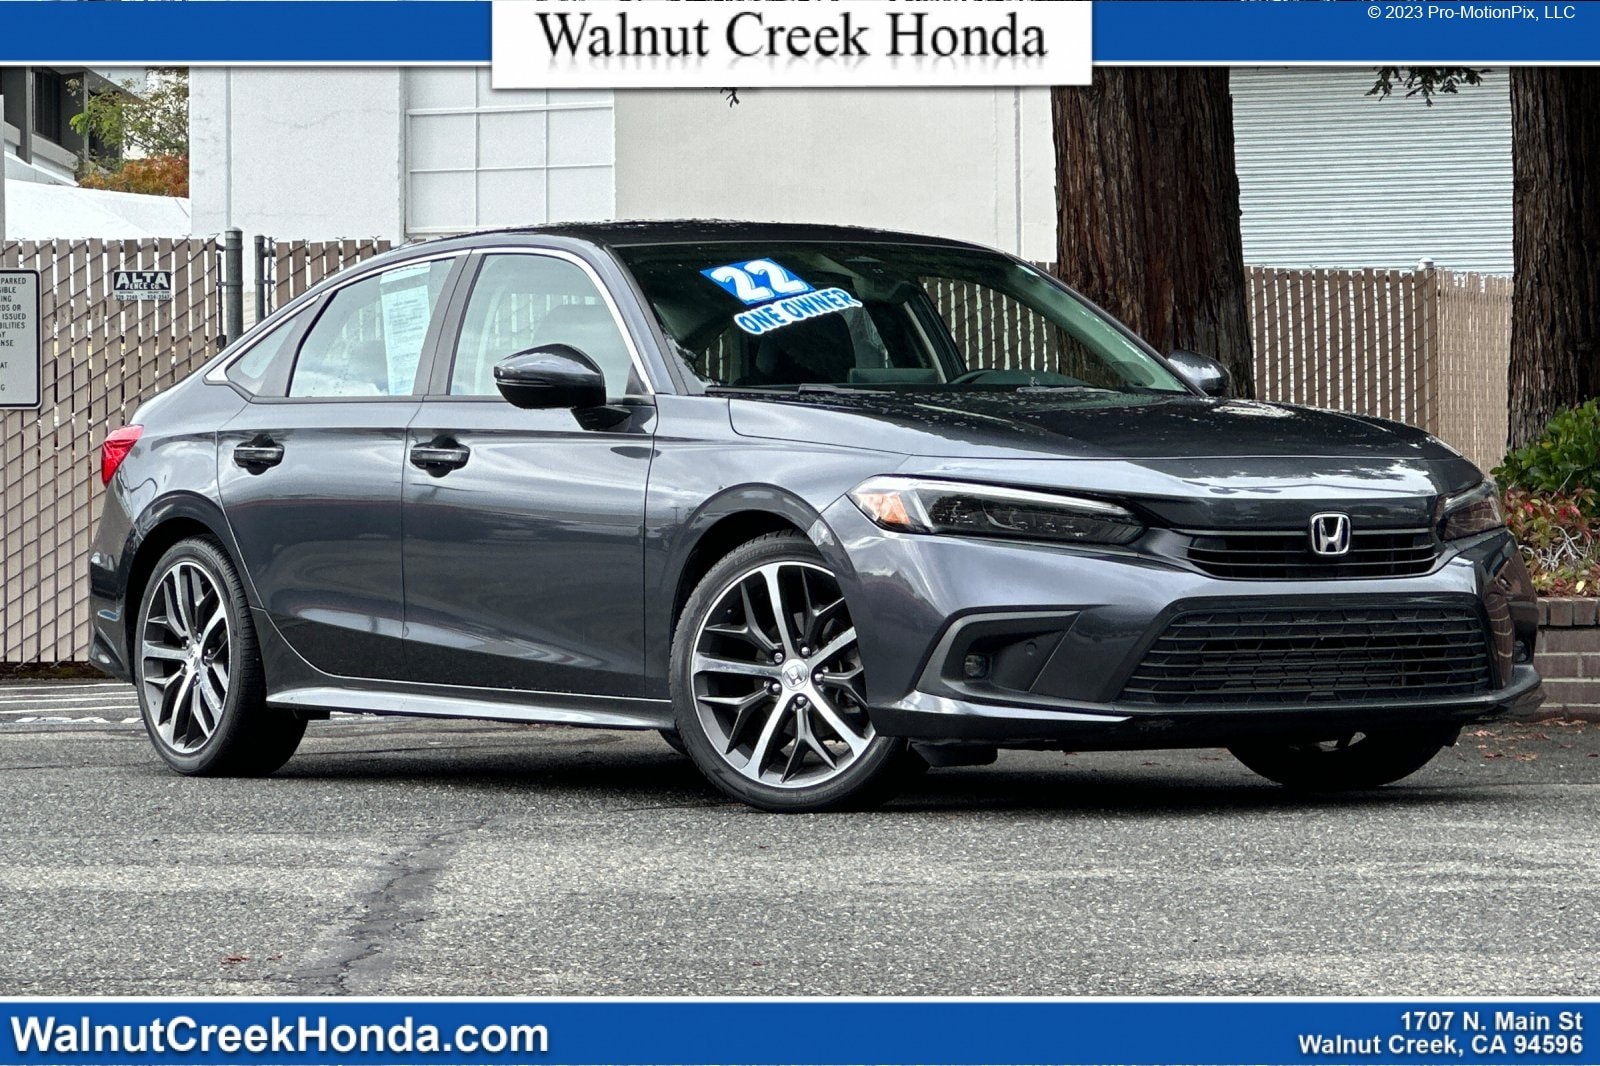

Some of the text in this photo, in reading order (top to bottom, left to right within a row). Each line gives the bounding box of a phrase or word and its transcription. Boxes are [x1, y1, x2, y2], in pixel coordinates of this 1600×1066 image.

[0, 277, 27, 285] PARKED
[115, 272, 169, 289] ALTA
[709, 260, 808, 301] 22
[124, 282, 148, 290] FENCE
[12, 303, 22, 312] OR
[737, 289, 860, 333] ONE OWNER
[1, 312, 27, 321] ISSUED
